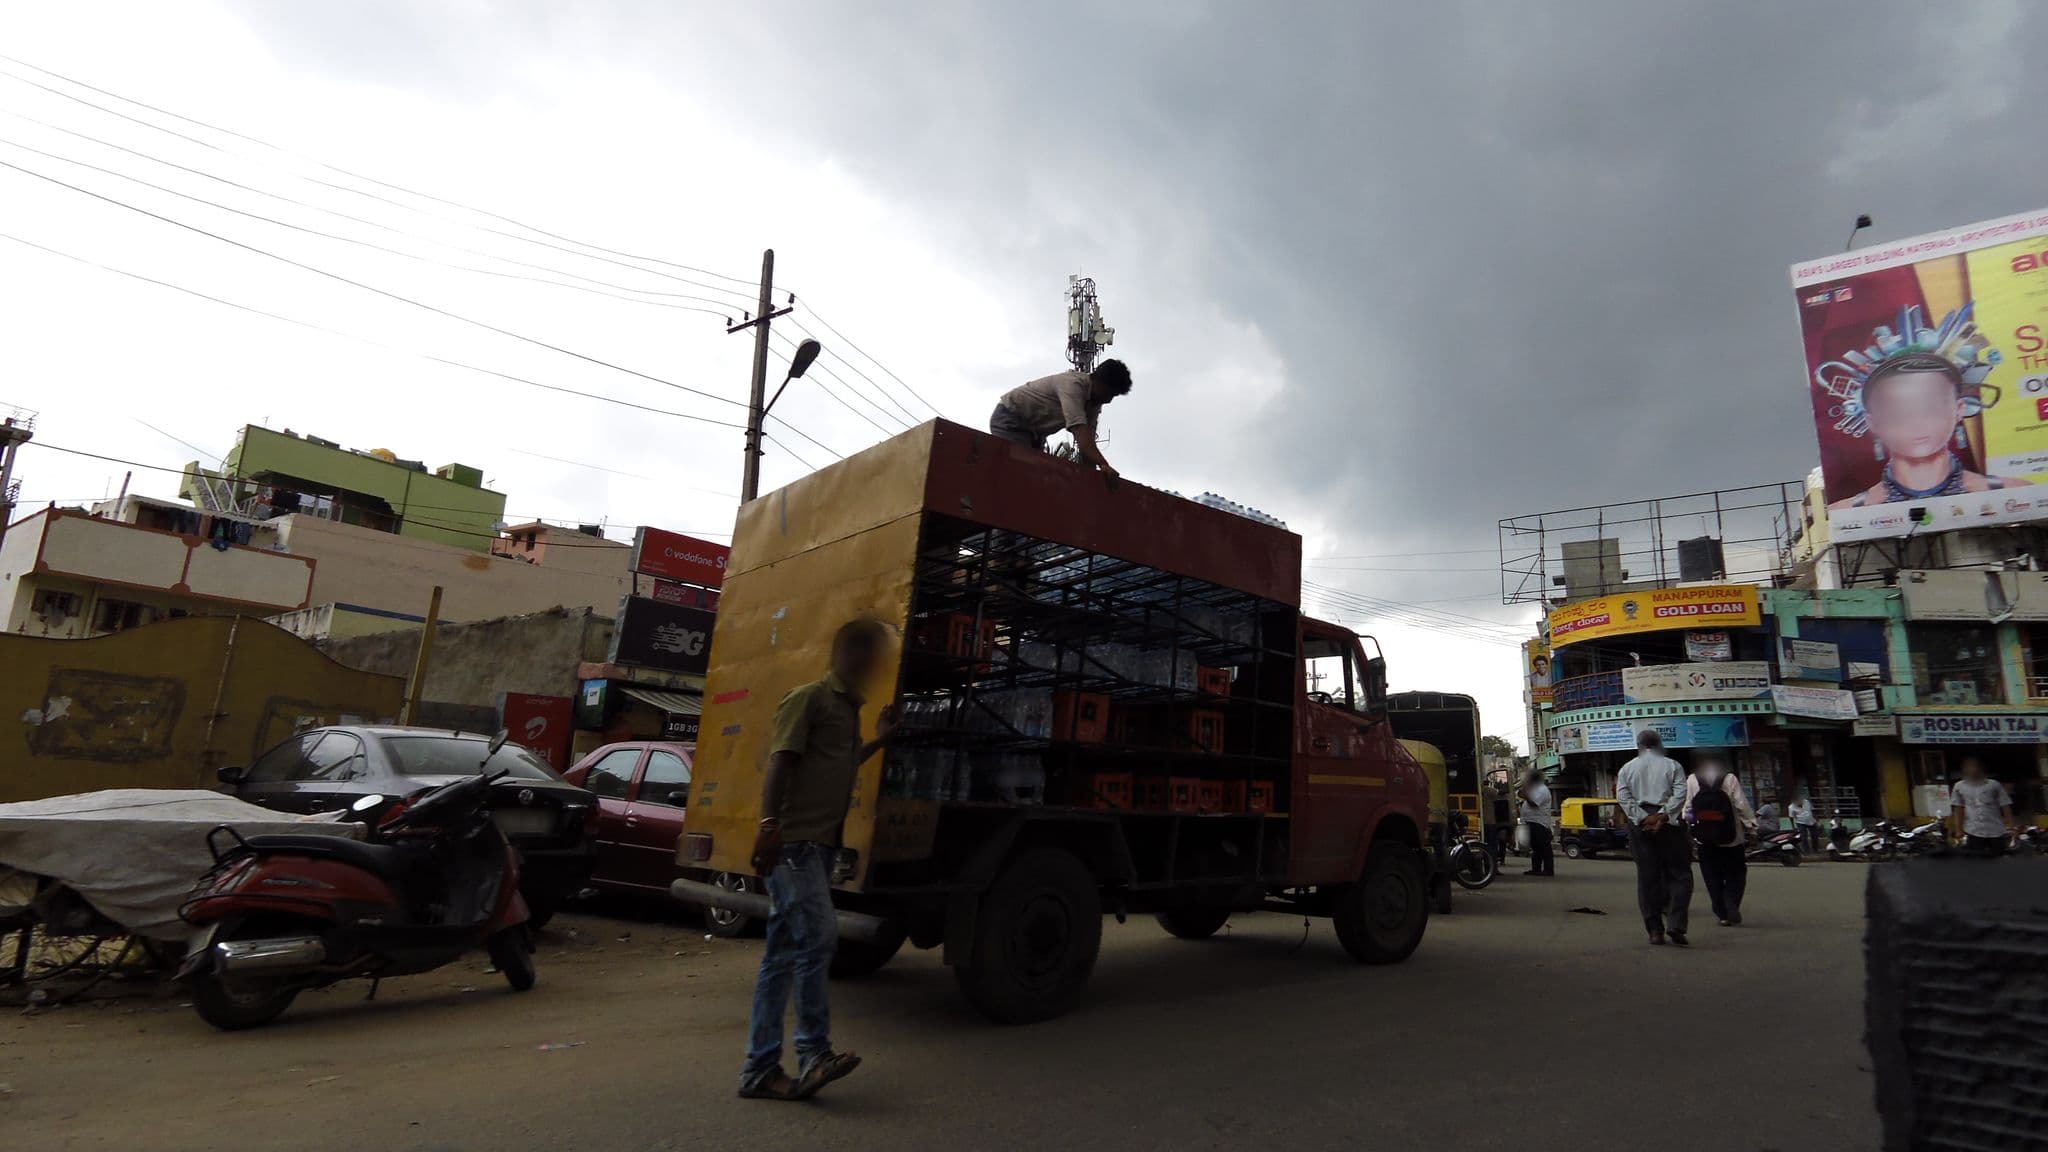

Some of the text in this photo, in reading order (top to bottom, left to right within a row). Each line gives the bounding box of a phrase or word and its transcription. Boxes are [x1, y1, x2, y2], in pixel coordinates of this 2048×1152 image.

[1827, 256, 1862, 273] LARGEST
[1864, 247, 1905, 265] BUILDING
[1906, 237, 1956, 255] MATERIALS
[673, 550, 713, 567] vodafone
[1652, 588, 1743, 602] MANAPPURAM
[1657, 603, 1743, 617] GOLD LOAN
[669, 722, 686, 732] 1GB
[1924, 717, 2038, 732] ROSHAN TAJ
